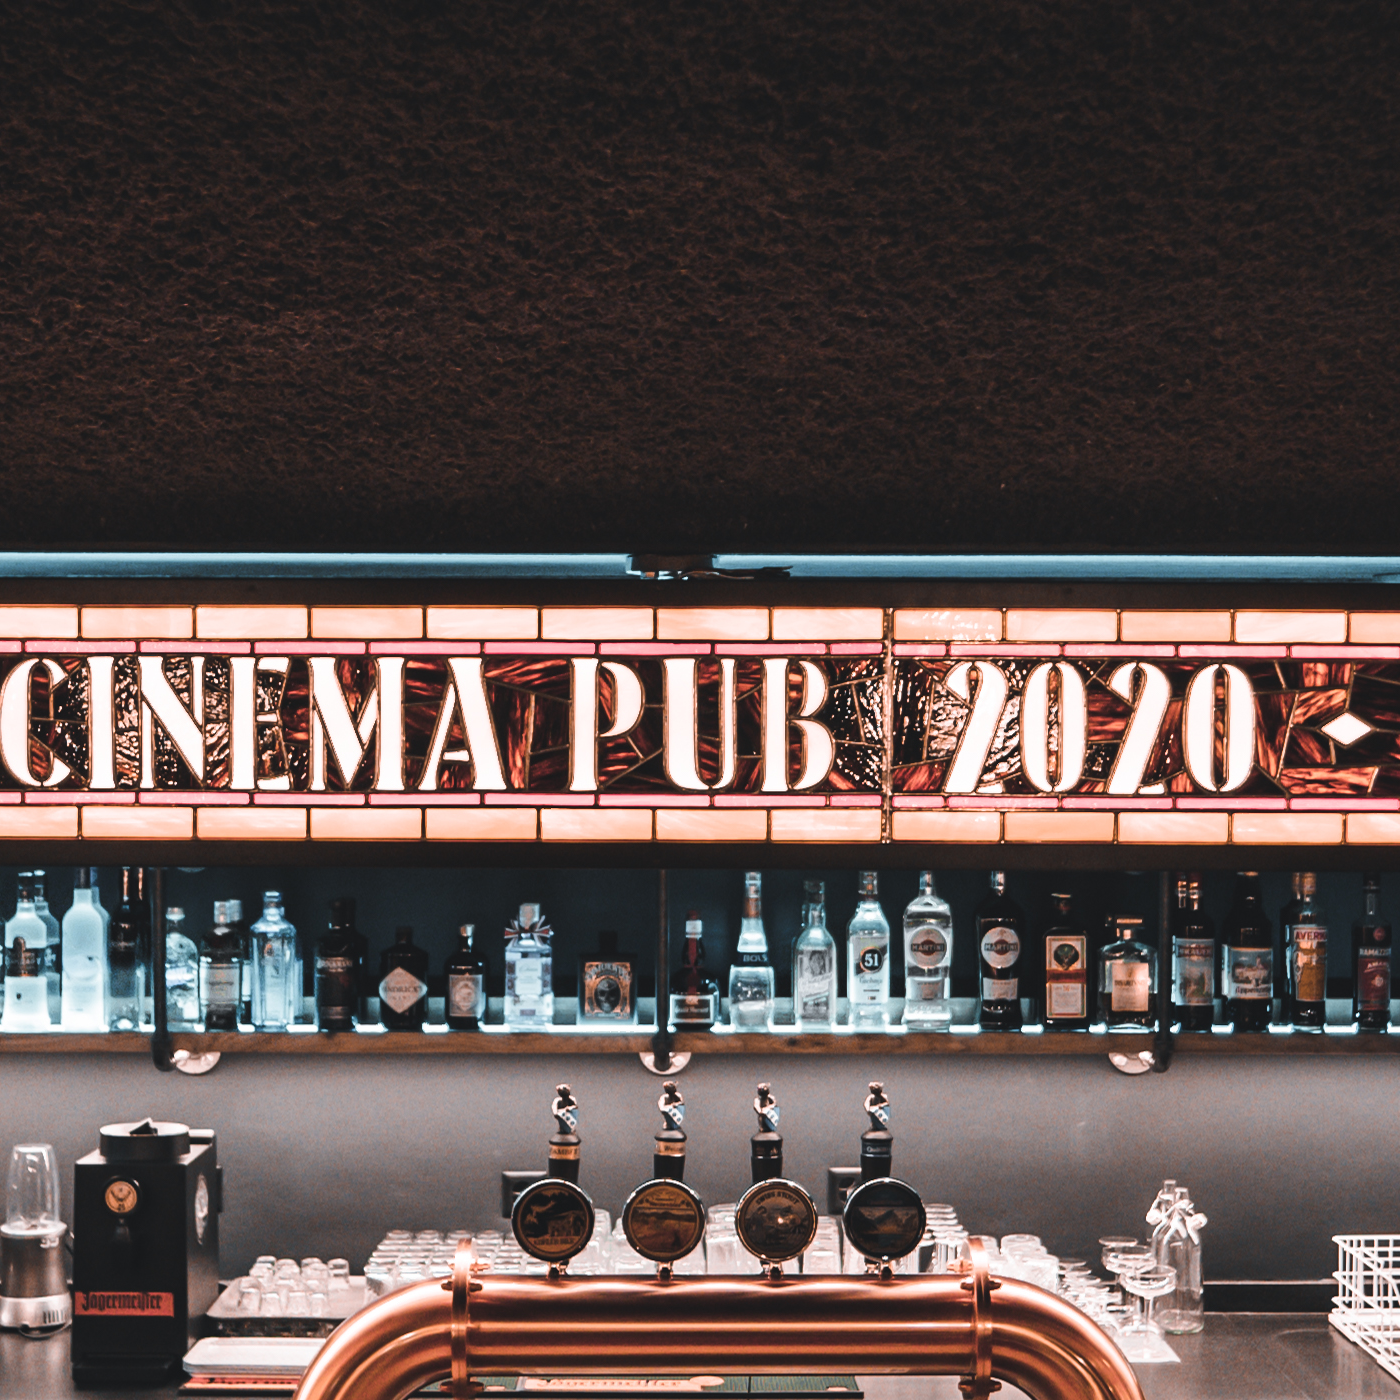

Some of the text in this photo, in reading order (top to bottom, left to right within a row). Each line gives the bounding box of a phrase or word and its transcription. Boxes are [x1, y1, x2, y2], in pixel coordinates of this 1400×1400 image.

[0, 655, 509, 792] CINEMA
[567, 657, 833, 793] PUB
[944, 660, 1255, 795] 2020
[1295, 931, 1328, 941] AVERN
[912, 943, 945, 951] MARTINI
[985, 943, 1019, 951] MARTINI
[743, 954, 768, 962] BOLS
[864, 953, 879, 967] 51
